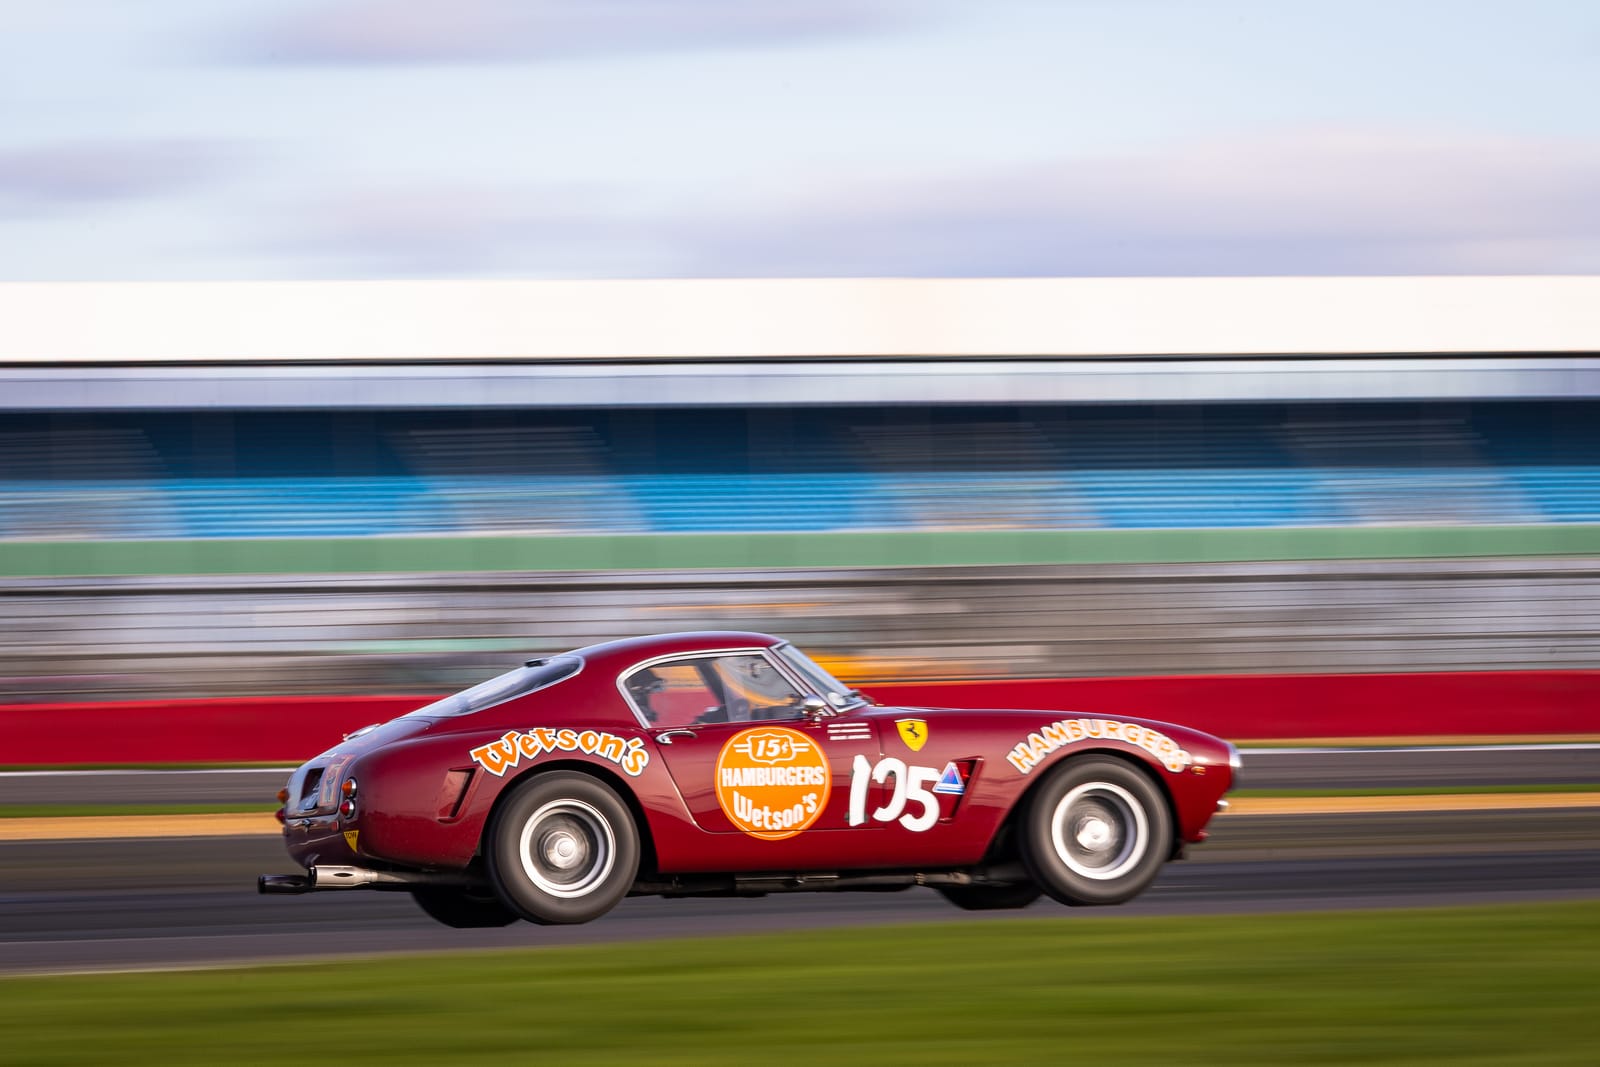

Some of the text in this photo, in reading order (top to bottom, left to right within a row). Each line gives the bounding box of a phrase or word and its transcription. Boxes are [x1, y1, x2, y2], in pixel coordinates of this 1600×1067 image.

[469, 727, 650, 777] Wetson's
[1006, 718, 1192, 774] HAMBURGERS
[721, 766, 825, 787] HAMBURGERS
[733, 790, 818, 830] Wetson's
